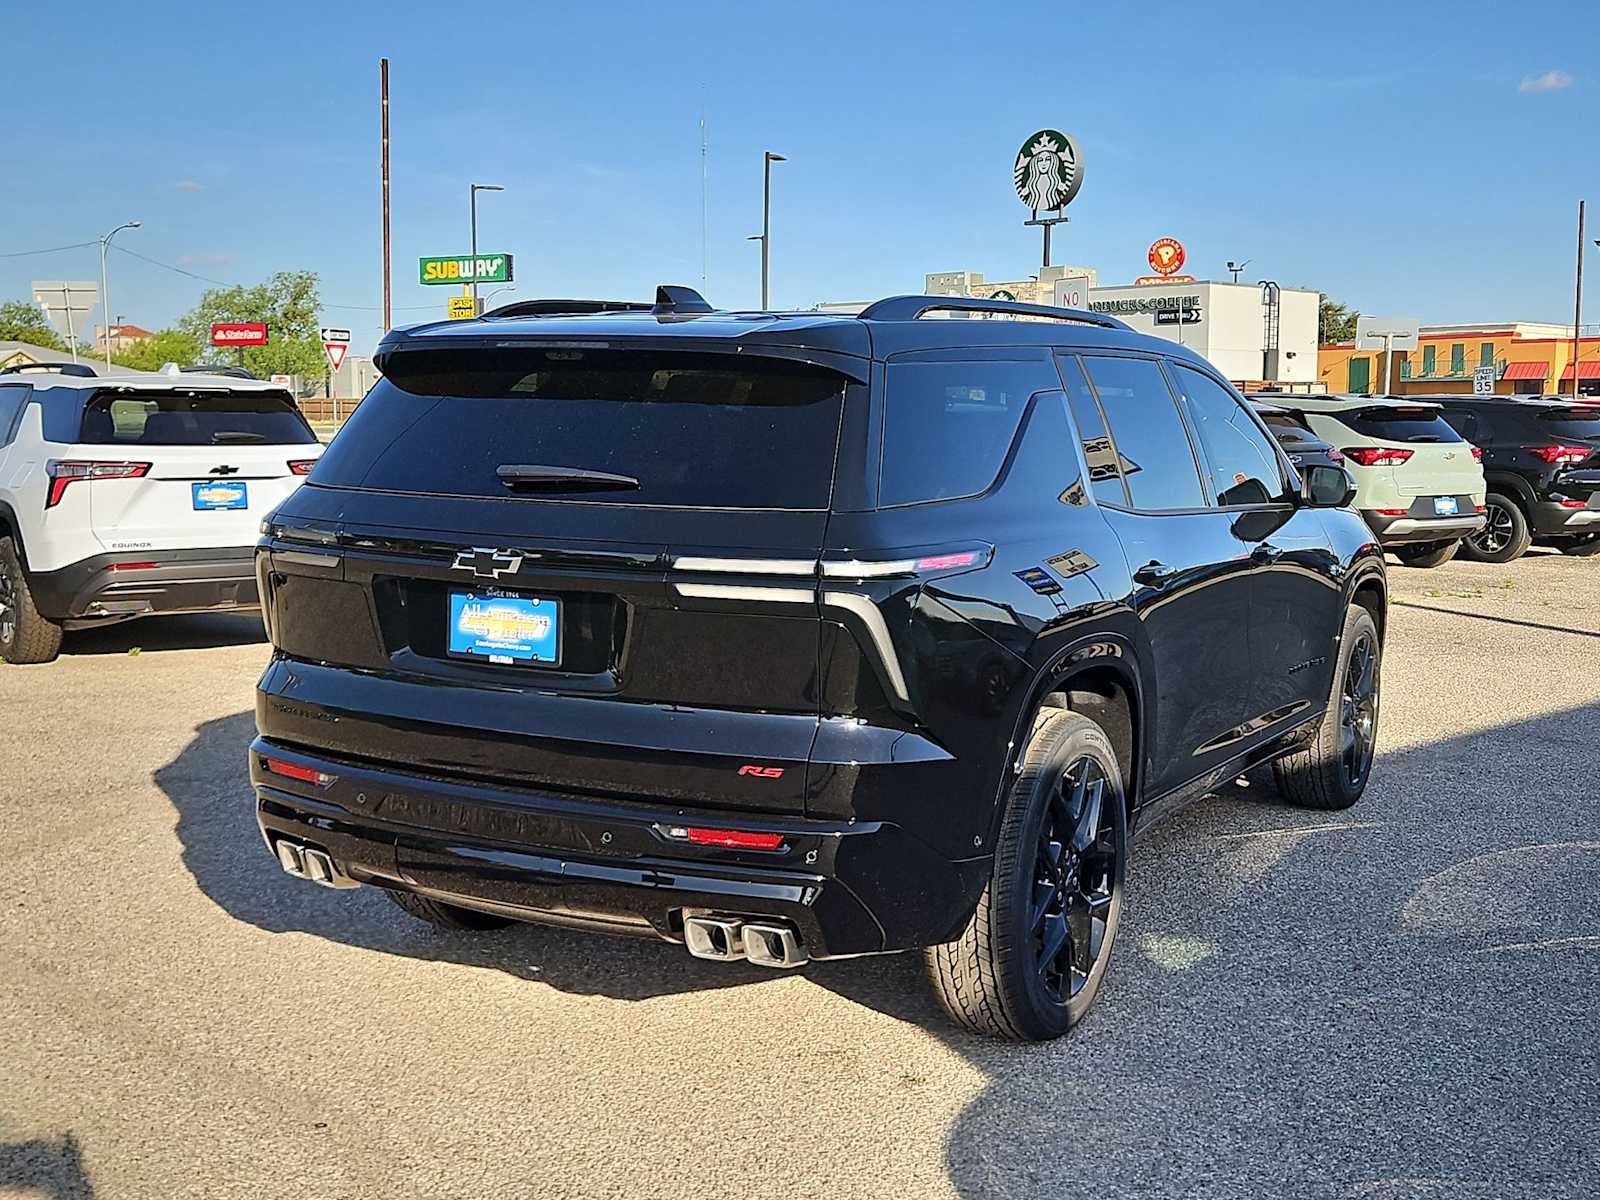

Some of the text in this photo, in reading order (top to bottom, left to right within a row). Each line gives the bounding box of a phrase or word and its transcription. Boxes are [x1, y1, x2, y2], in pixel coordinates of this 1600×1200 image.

[423, 258, 502, 280] SUBWAY
[453, 300, 473, 308] CASH
[1063, 292, 1079, 306] NO
[1149, 296, 1199, 310] COFFEE
[1159, 312, 1191, 321] DRIVE TRU
[1476, 381, 1491, 392] 35
[737, 765, 784, 778] RS
